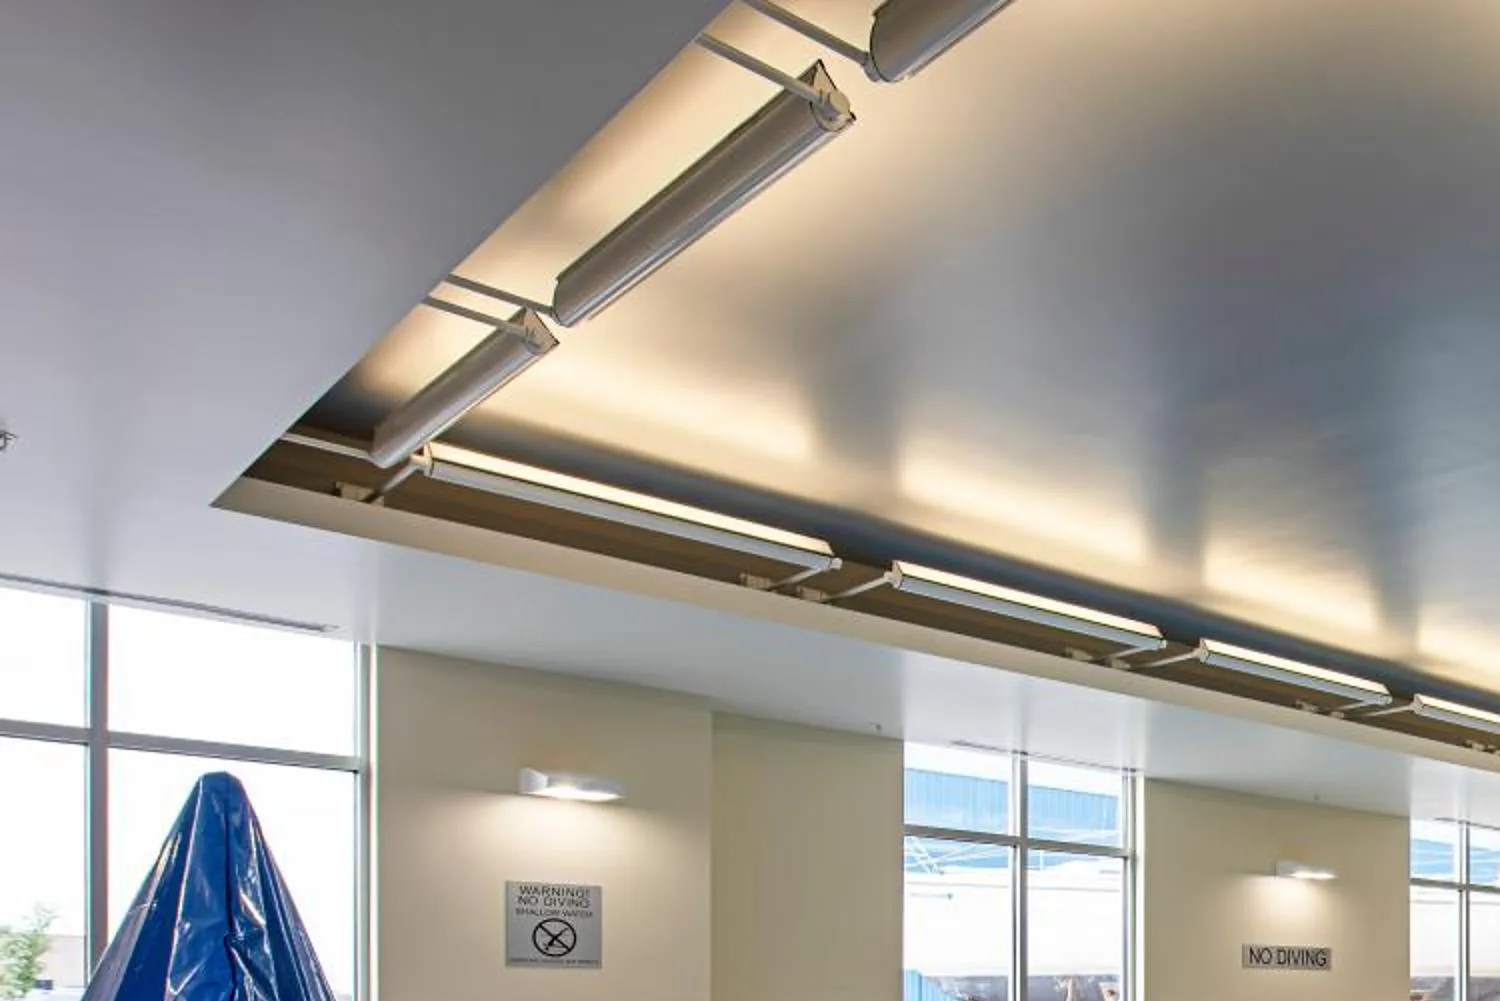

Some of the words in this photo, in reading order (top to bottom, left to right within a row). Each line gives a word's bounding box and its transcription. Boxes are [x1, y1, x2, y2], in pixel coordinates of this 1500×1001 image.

[517, 895, 539, 906] NO
[543, 897, 591, 908] DIVING
[1249, 946, 1272, 965] NO
[1276, 949, 1327, 967] DIVING
